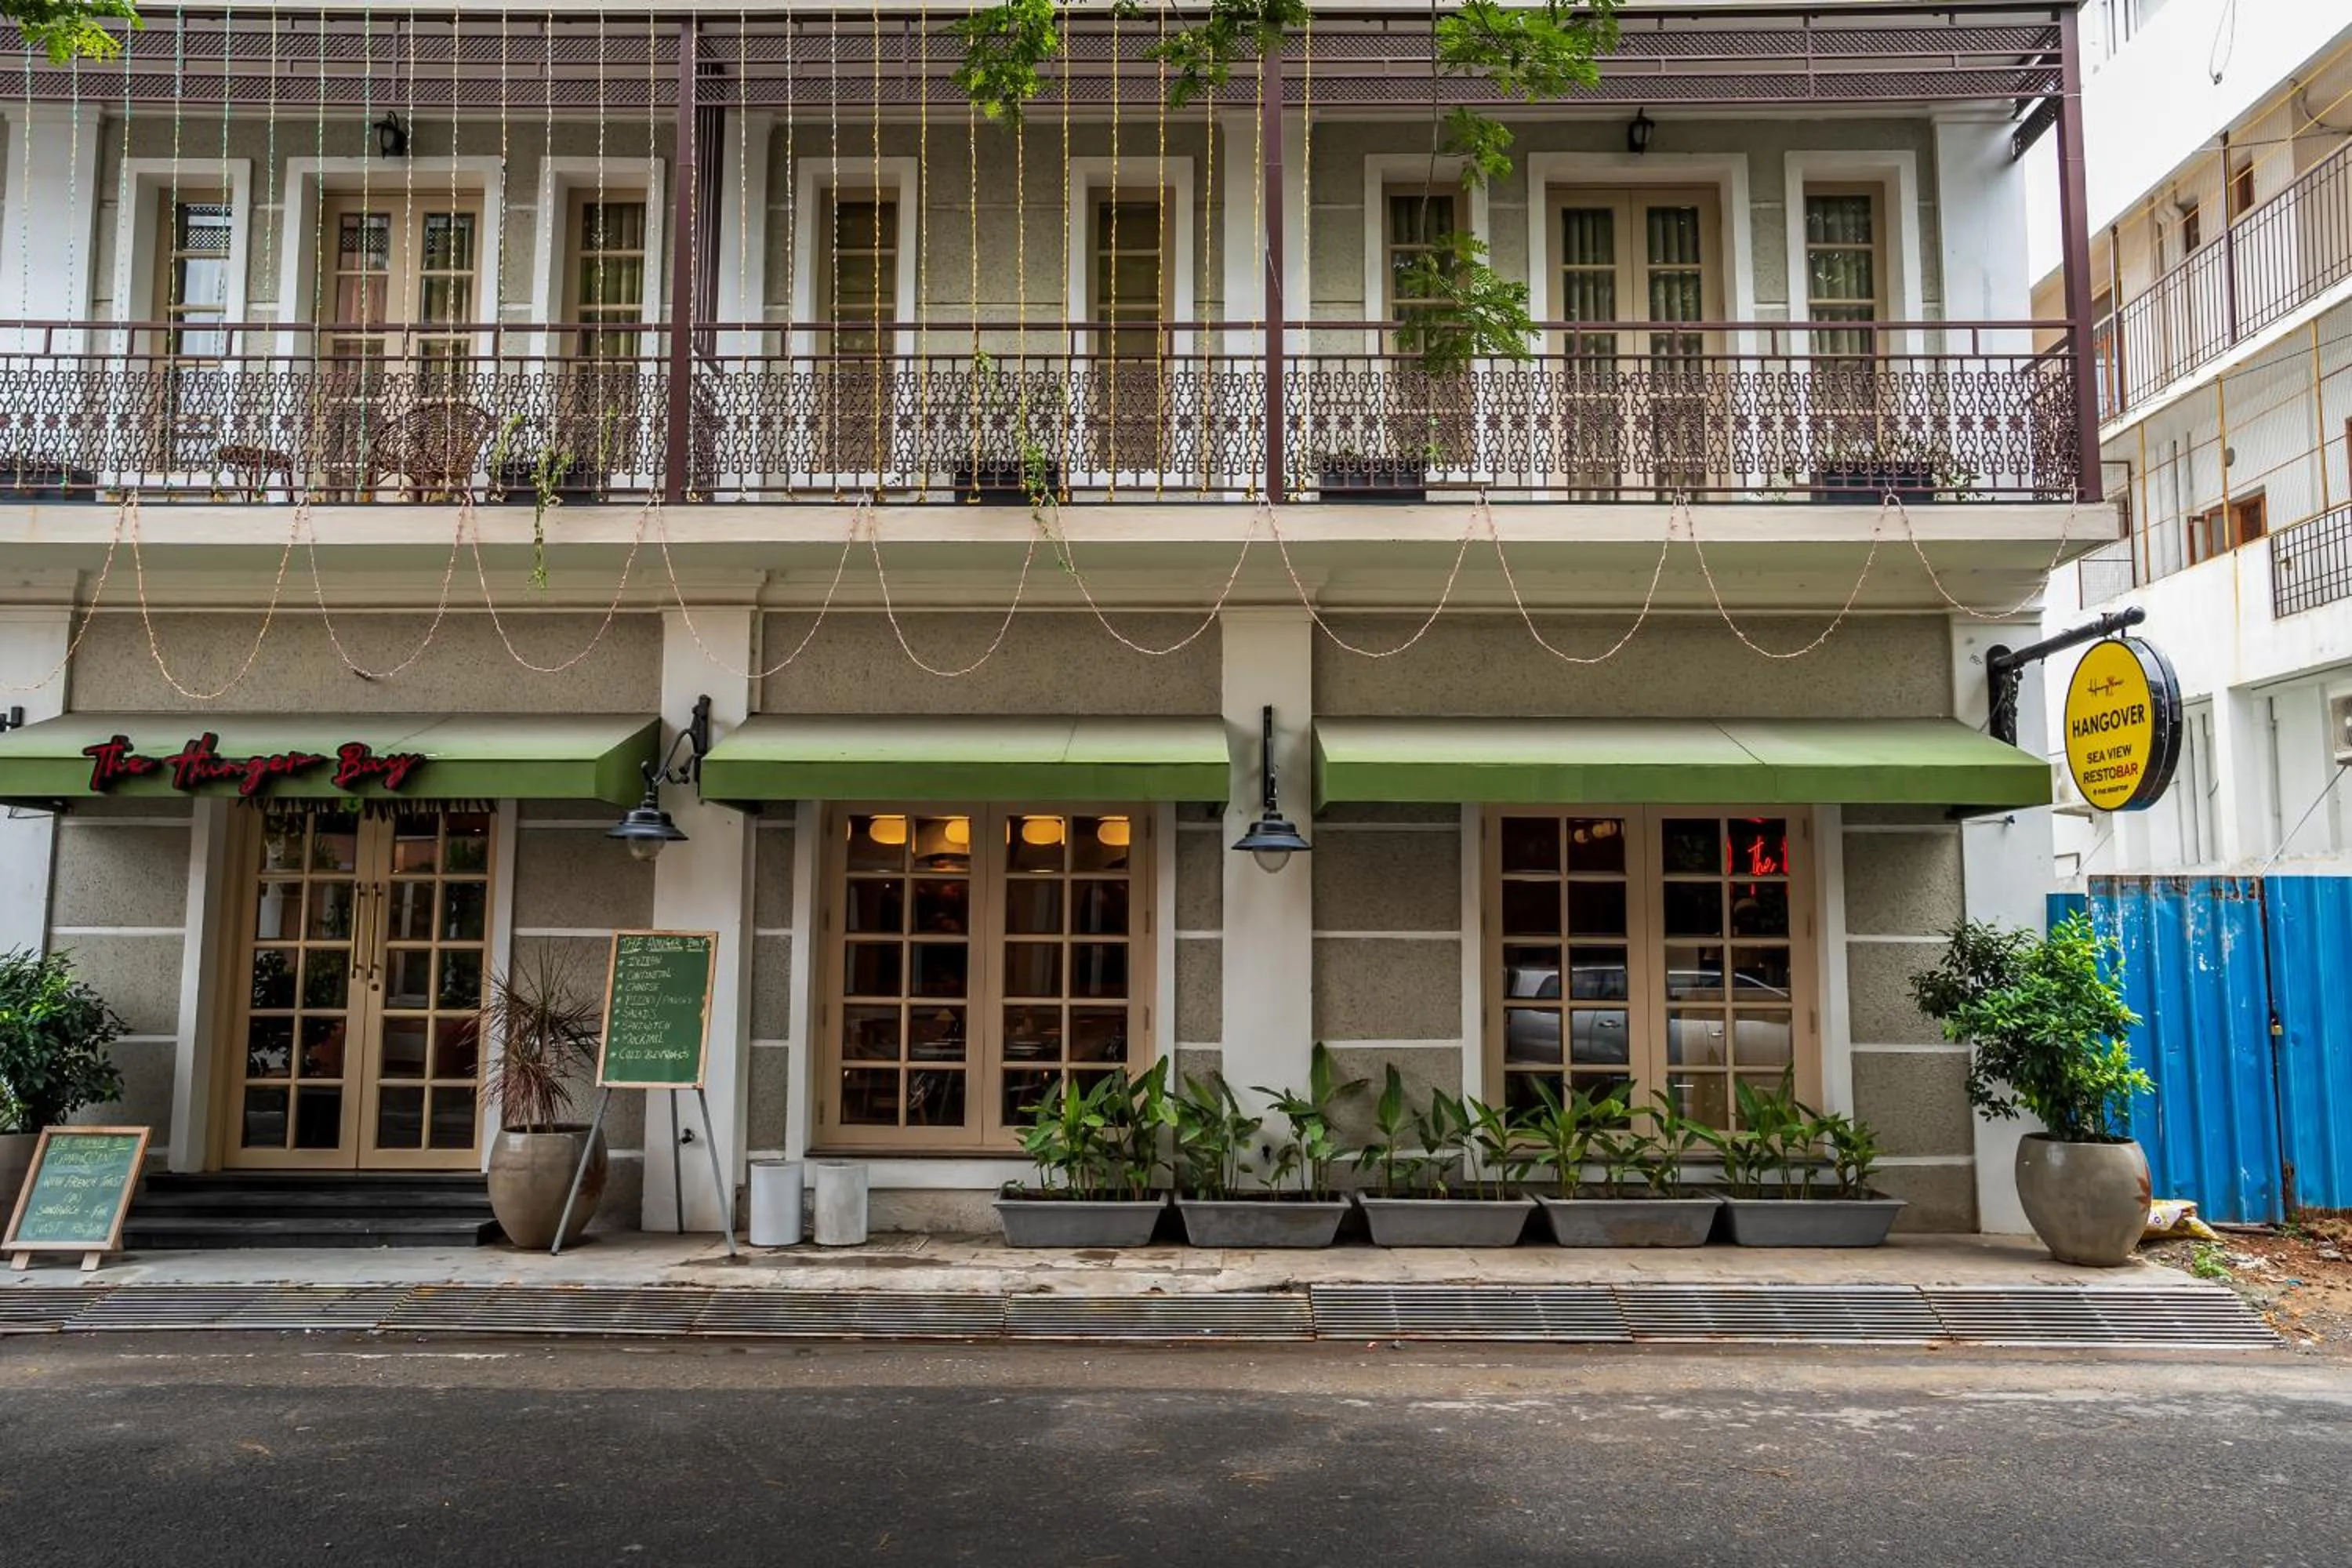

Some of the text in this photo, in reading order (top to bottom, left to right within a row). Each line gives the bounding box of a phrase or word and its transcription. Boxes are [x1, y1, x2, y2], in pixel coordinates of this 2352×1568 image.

[2072, 704, 2145, 739] HANGOVER
[83, 732, 426, 795] The Hunger Bay
[2086, 744, 2132, 764] SEA VIEW
[2083, 762, 2139, 784] RESTOBAR
